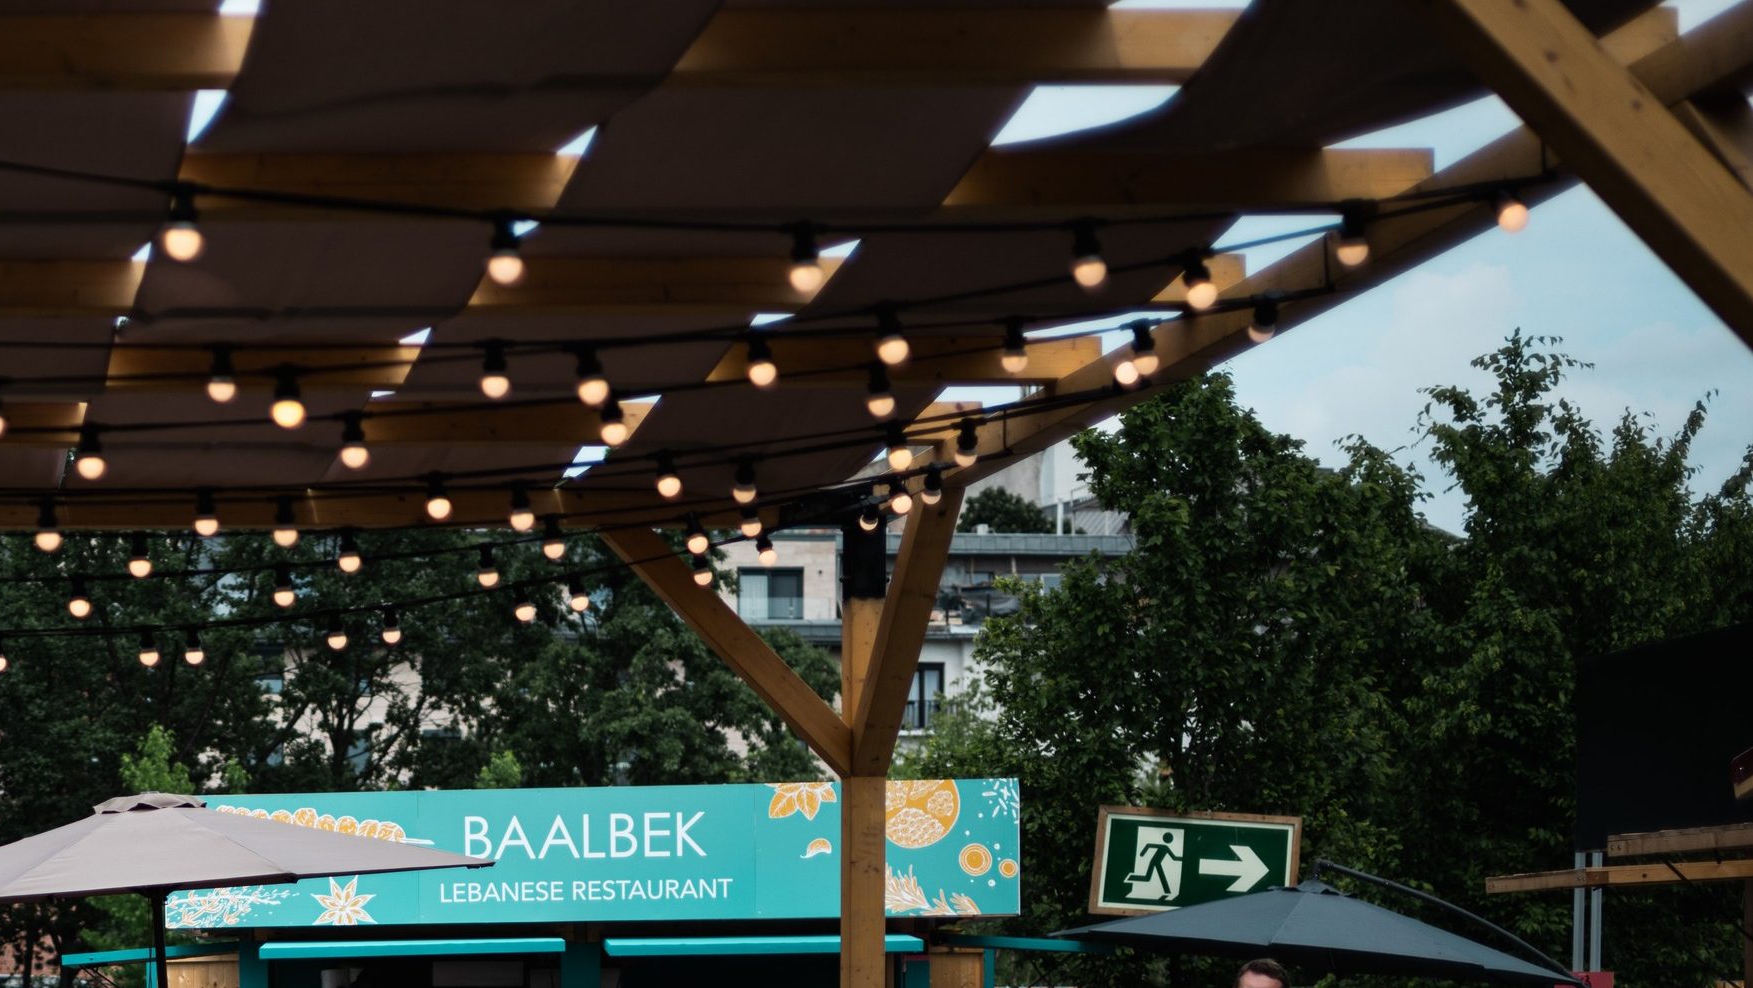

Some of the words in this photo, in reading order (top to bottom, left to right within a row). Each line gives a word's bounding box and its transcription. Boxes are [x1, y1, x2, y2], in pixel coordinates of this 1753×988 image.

[464, 811, 707, 860] BAALBEK
[440, 881, 564, 903] LEBANESE
[572, 878, 733, 901] RESTAURANT
